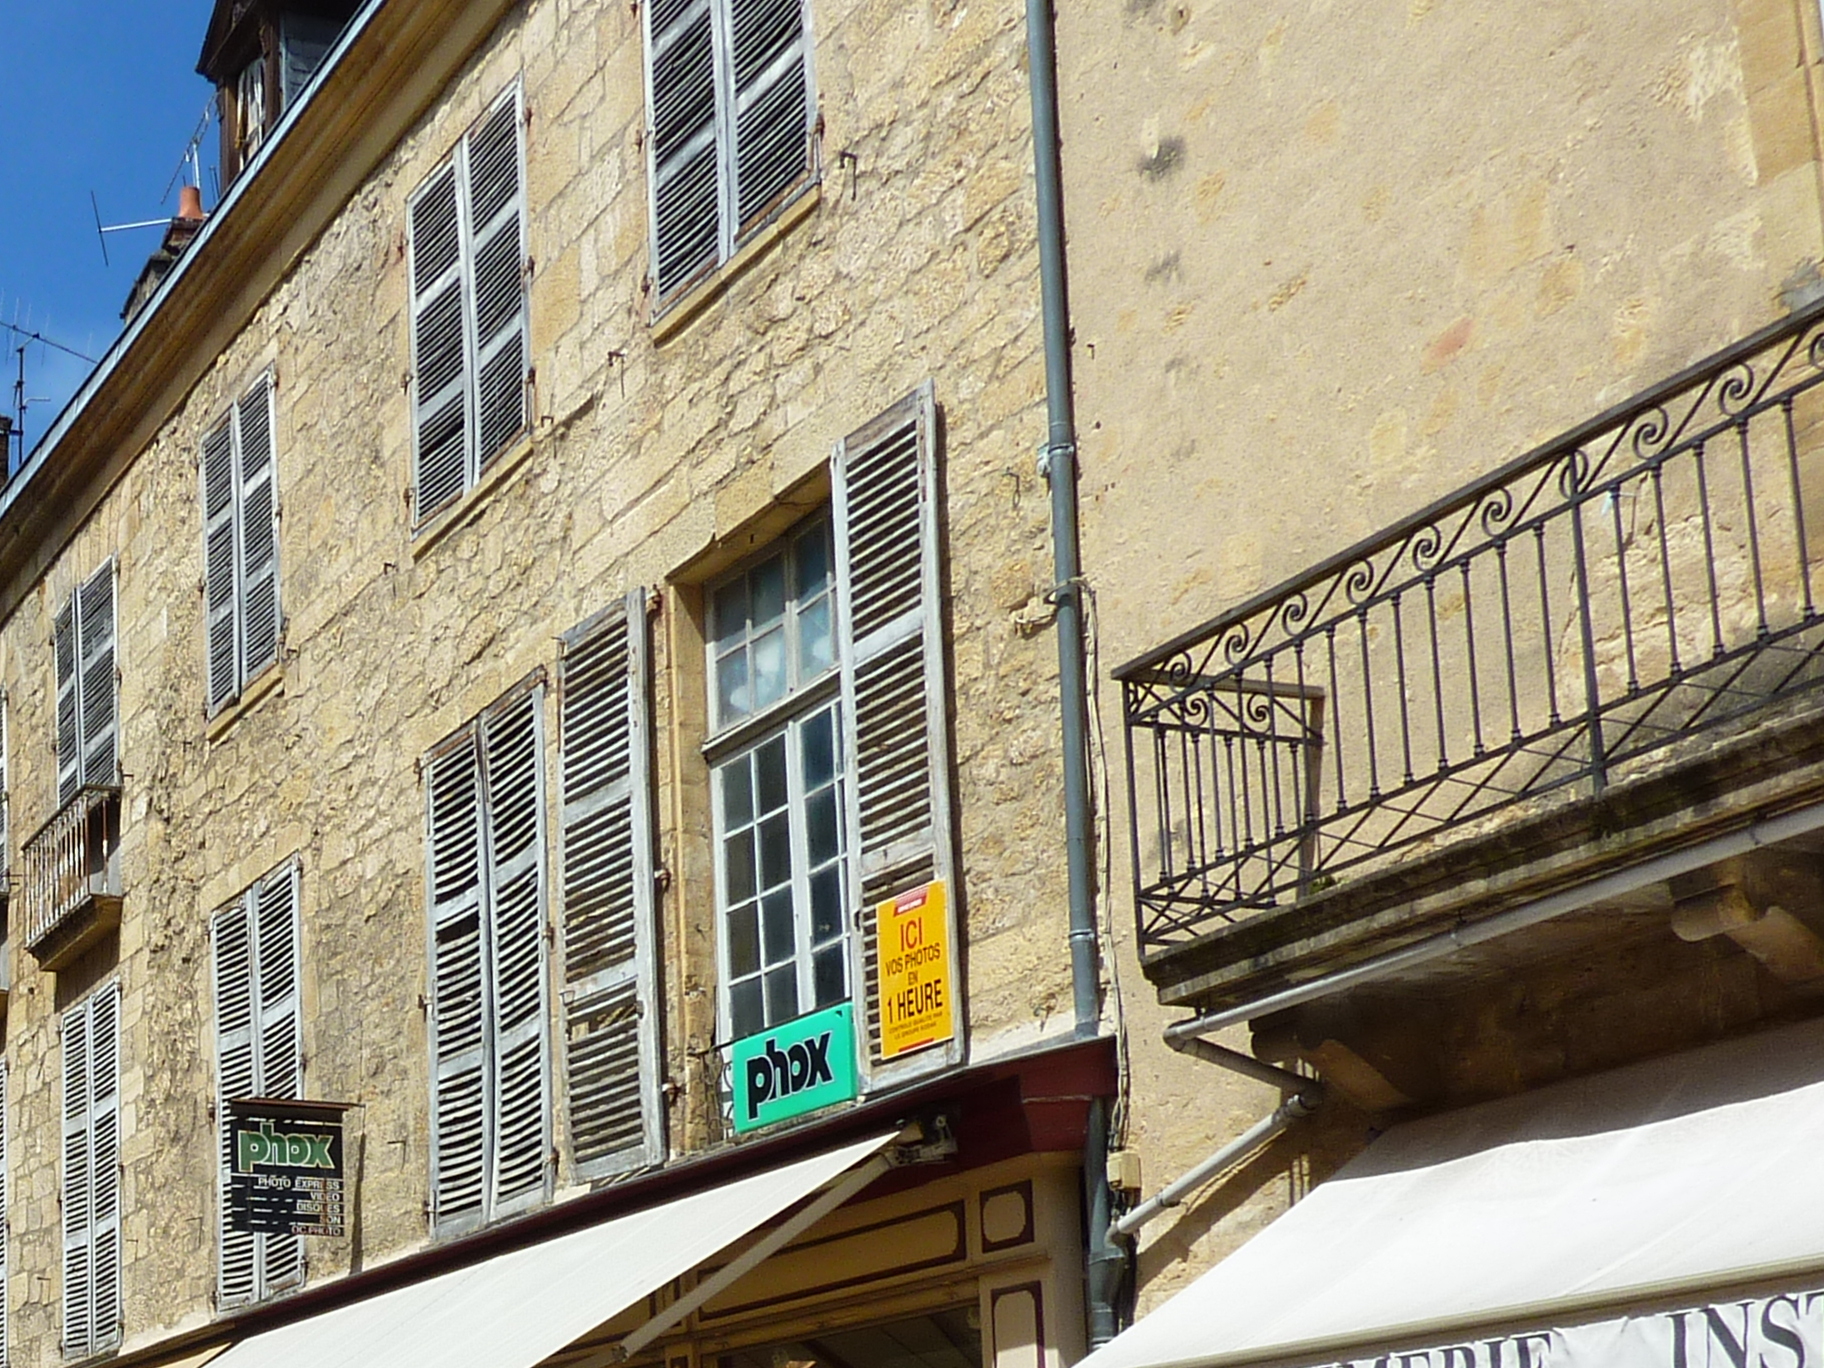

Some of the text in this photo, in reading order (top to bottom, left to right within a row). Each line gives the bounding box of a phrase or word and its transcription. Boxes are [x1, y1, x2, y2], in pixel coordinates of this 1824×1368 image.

[900, 916, 923, 952] ICI
[885, 942, 941, 977] VOS PHOTOS
[887, 978, 943, 1024] 1 HEURE
[746, 1030, 834, 1121] phox
[238, 1122, 335, 1173] phox
[258, 1177, 291, 1188] PHOTO
[310, 1191, 340, 1201] VIDEO
